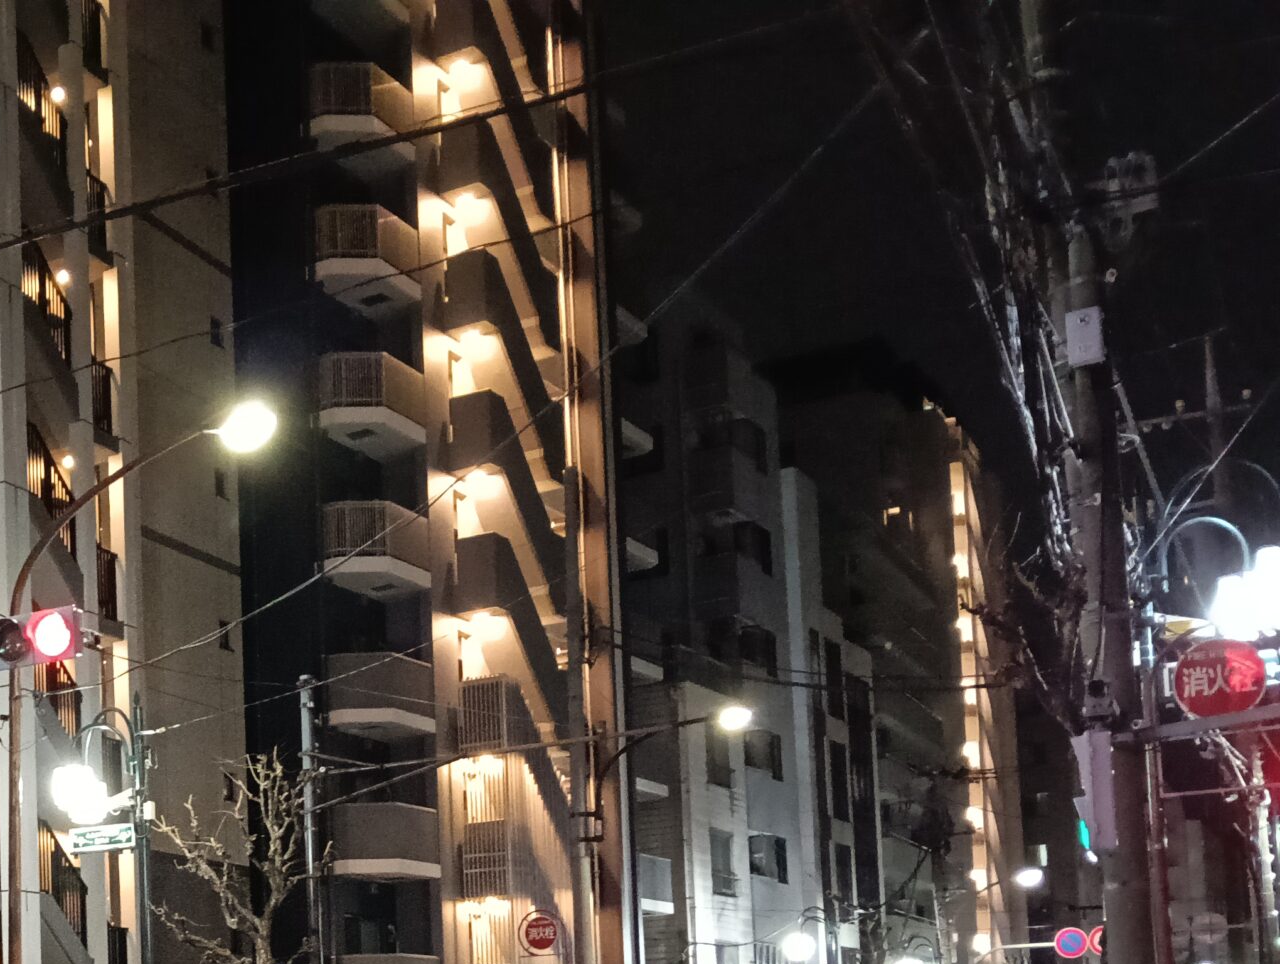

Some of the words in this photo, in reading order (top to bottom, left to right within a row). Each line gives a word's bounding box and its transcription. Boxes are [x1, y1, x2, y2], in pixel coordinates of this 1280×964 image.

[1183, 663, 1257, 697] 消火栓
[527, 926, 556, 941] 消火栓
